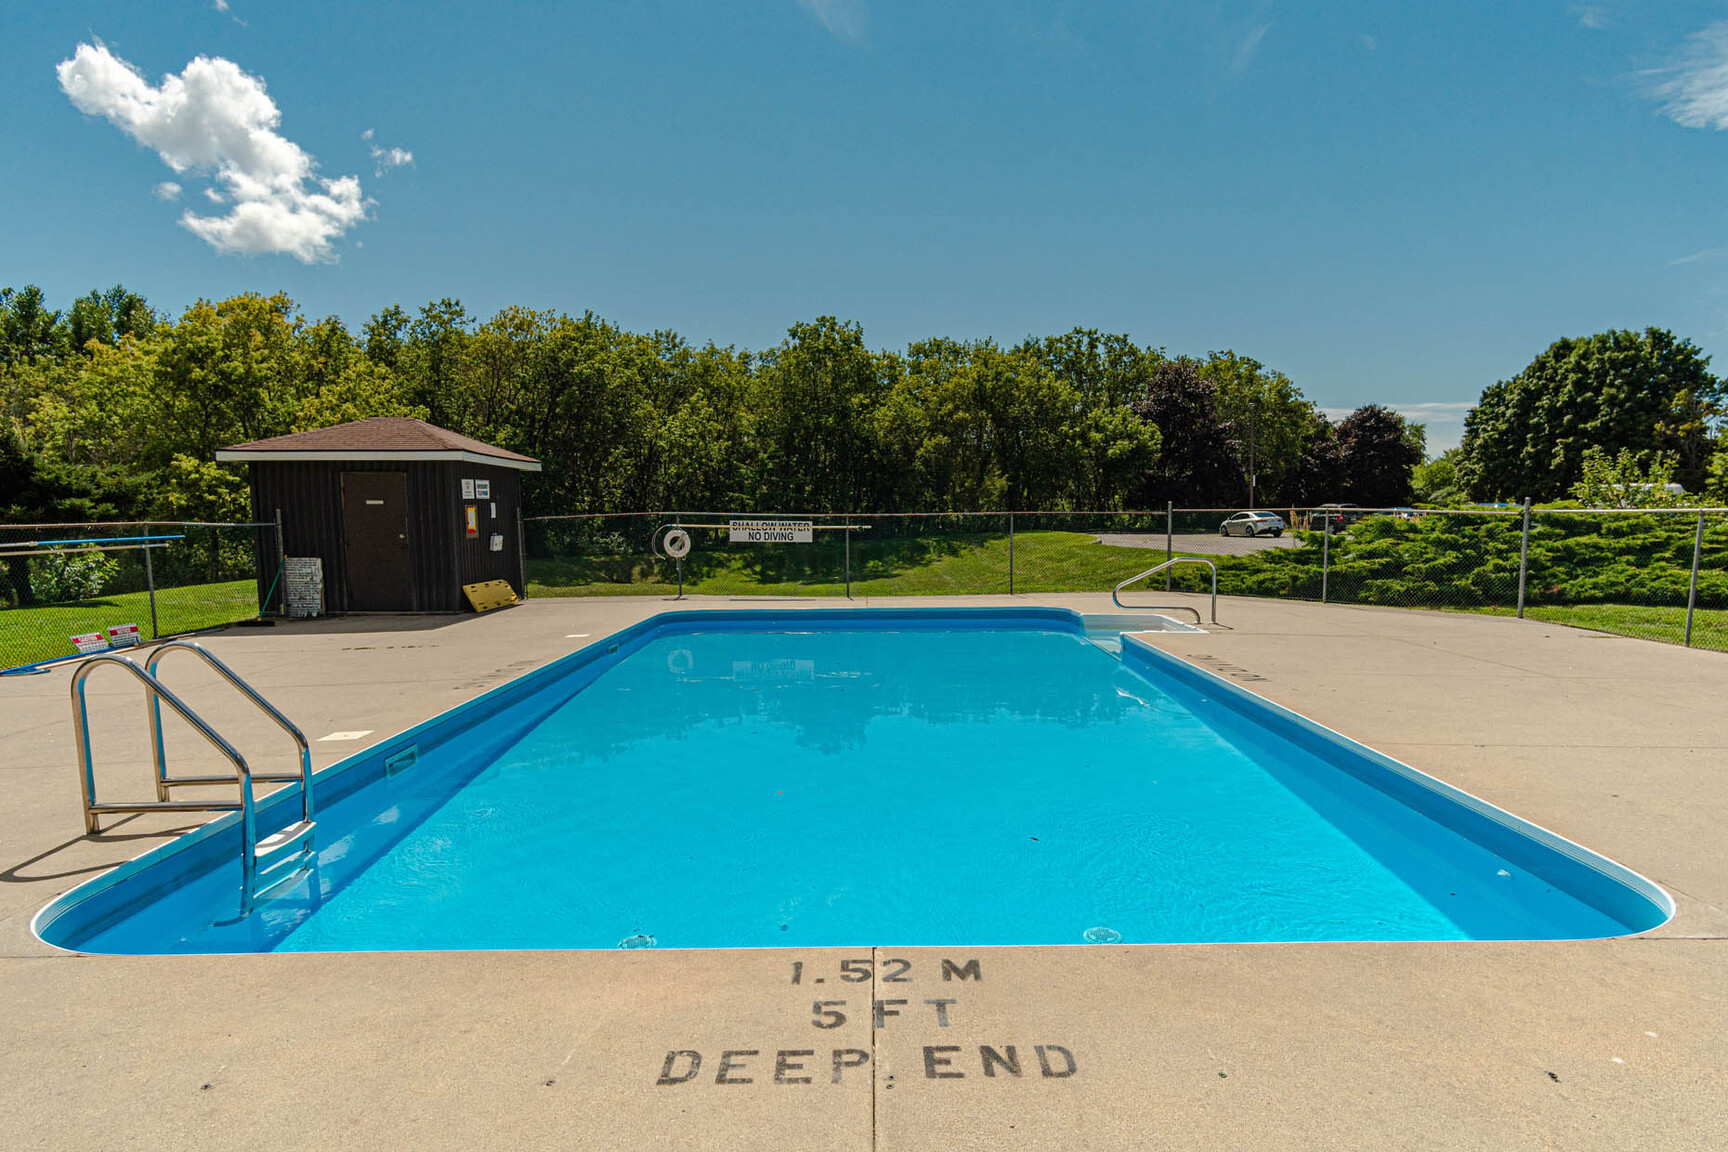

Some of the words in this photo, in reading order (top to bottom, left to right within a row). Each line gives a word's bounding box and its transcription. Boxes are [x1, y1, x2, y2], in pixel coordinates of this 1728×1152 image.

[732, 522, 776, 531] SHALLOW
[778, 522, 810, 531] WATER
[748, 532, 762, 541] NO
[763, 532, 794, 541] DIVING
[790, 958, 913, 985] 1.52
[940, 958, 982, 982] M
[811, 999, 847, 1030] 5
[873, 998, 957, 1029] FT
[655, 1048, 871, 1086] DEEP
[922, 1044, 1079, 1079] END
